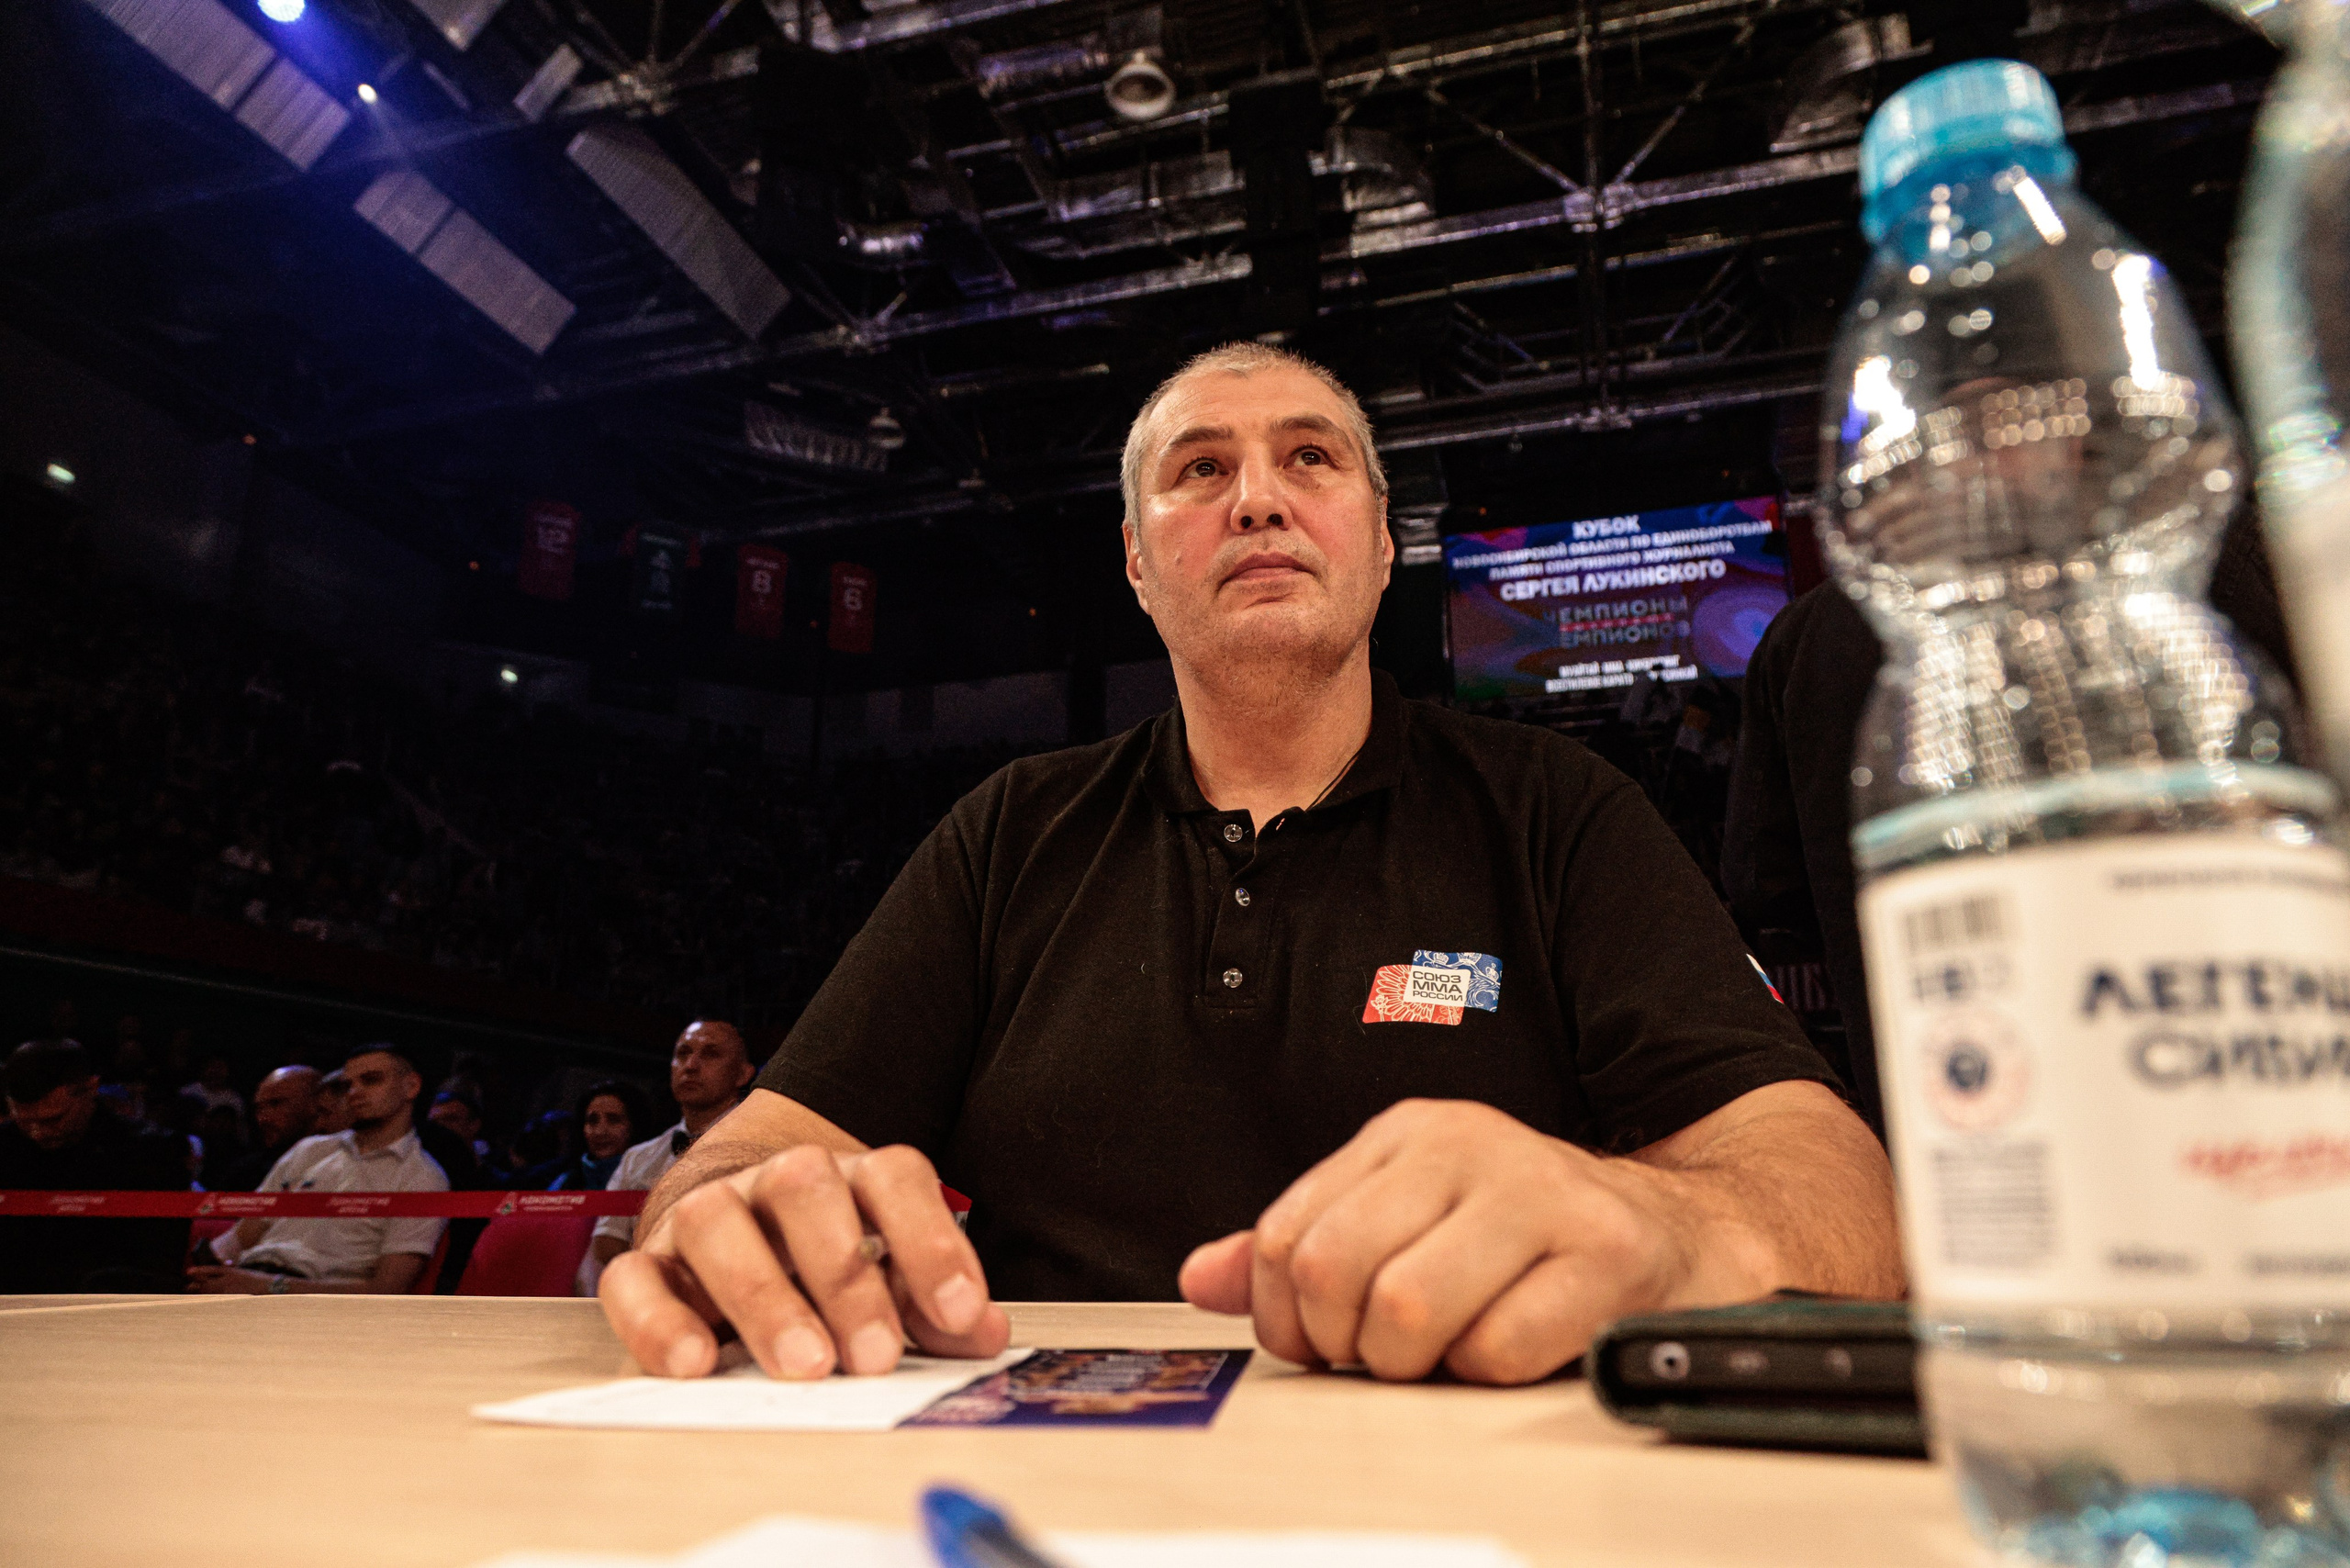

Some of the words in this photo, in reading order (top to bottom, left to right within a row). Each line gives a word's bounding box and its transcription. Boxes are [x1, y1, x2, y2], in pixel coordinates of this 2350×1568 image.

[1572, 514, 1640, 540] КУБОК
[1452, 542, 1568, 569] НОВОСИБИРСКОЙ
[1568, 537, 1629, 556] ОБЛАСТИ
[1630, 533, 1651, 548] ПО
[1651, 520, 1774, 546] ЕДИНОБОРСТВАМ
[1489, 562, 1543, 580] ПАМЯТИ
[1544, 550, 1641, 574] СПОРТИВНОГО
[1641, 540, 1735, 564] ЖУРНАЛИСТА
[1500, 574, 1580, 600] СЕРГЕЯ
[1582, 558, 1728, 593] ЛУКИНСКОГО
[1413, 970, 1461, 983] СОЮЗ
[1413, 980, 1462, 994] ММА
[1413, 991, 1463, 1002] РОССИИ
